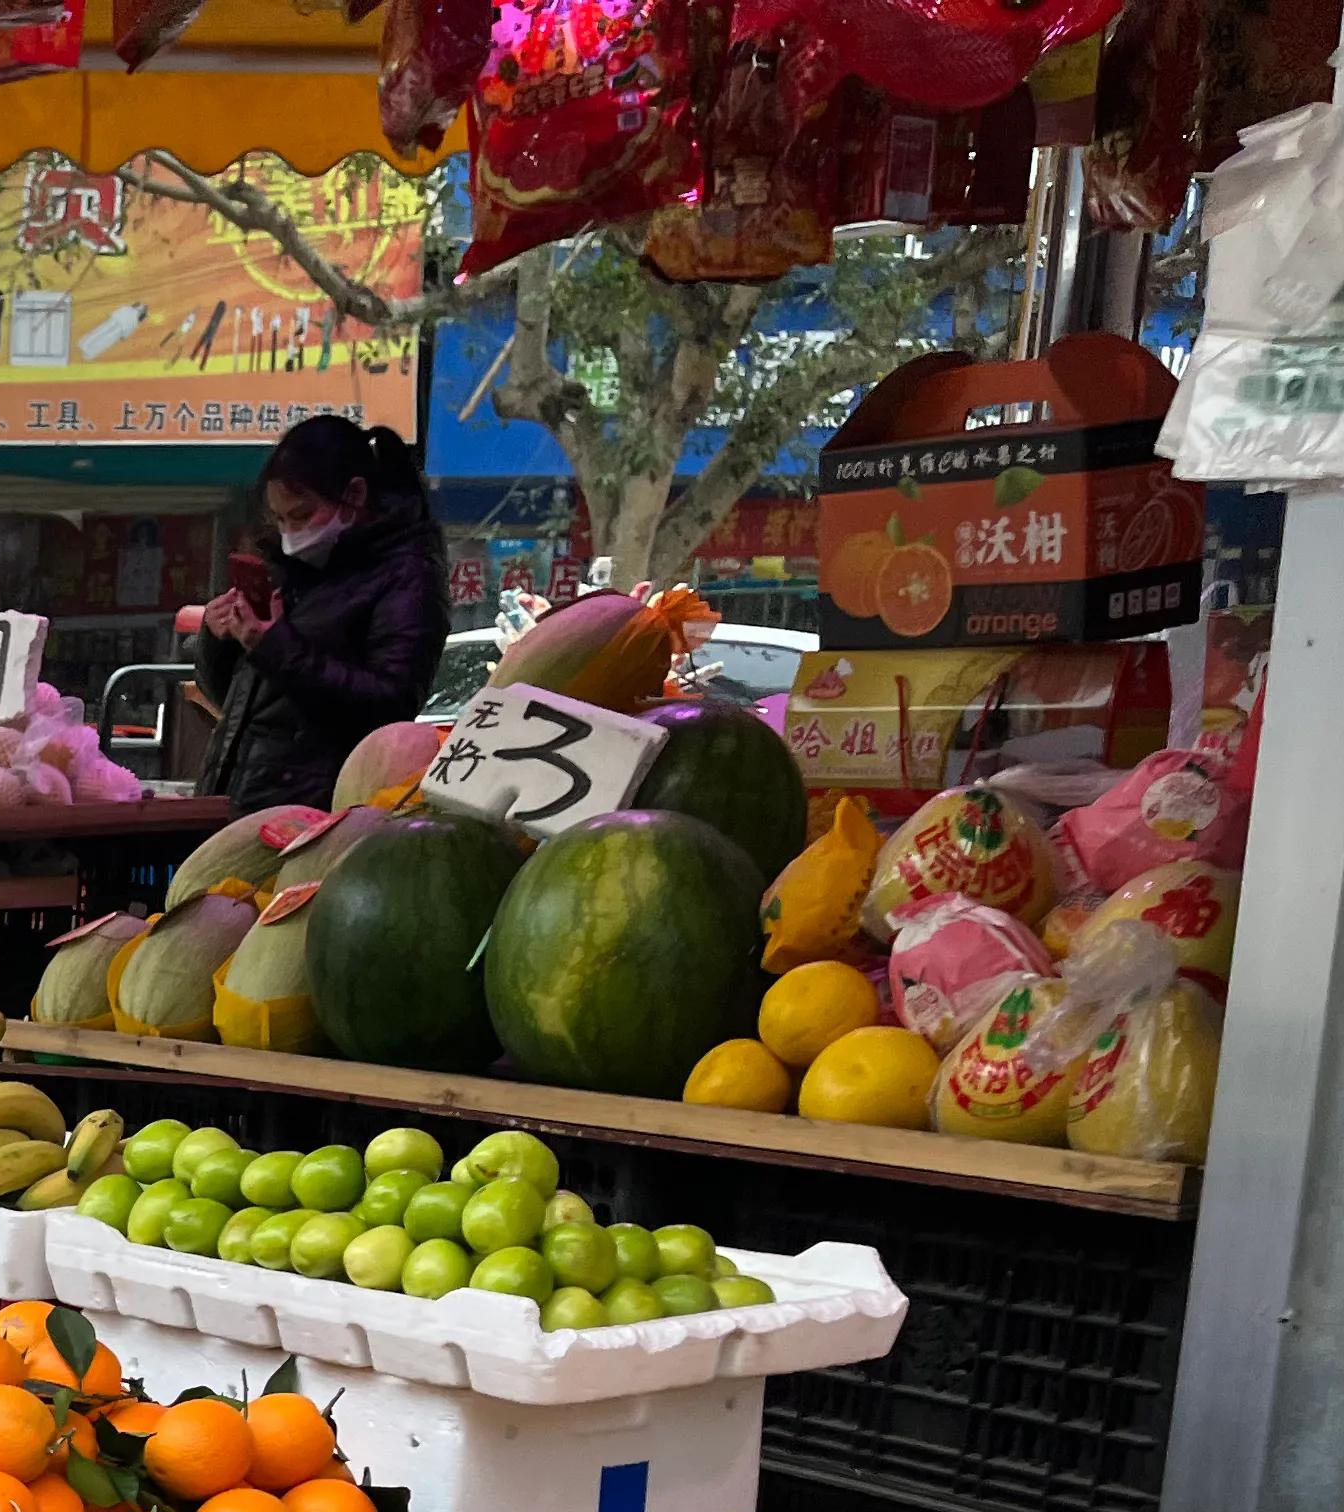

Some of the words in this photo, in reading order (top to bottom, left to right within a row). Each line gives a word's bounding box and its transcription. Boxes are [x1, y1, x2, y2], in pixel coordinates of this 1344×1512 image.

[976, 511, 1069, 566] 沃柑
[966, 611, 1058, 638] orange
[493, 699, 594, 822] 3
